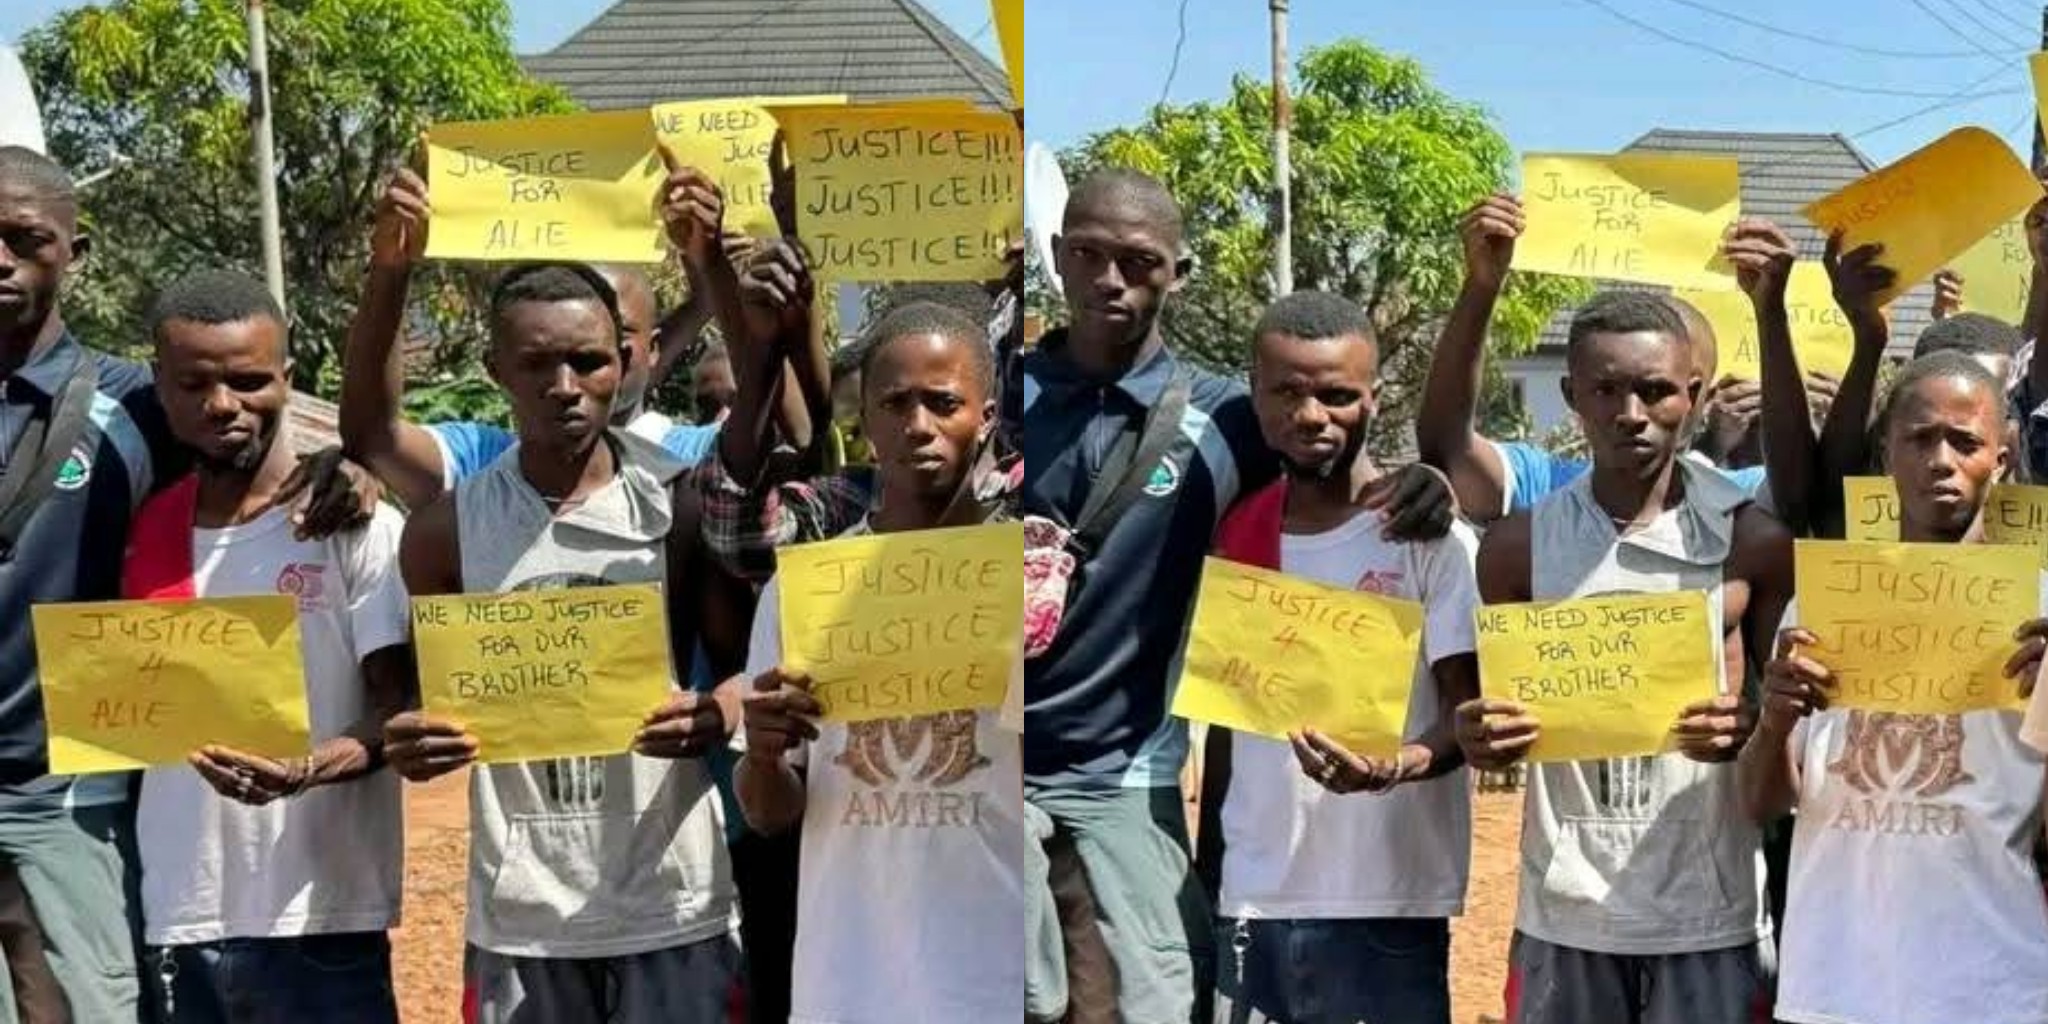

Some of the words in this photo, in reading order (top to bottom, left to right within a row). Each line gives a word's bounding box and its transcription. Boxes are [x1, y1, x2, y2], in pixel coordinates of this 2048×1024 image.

[654, 112, 683, 134] WE
[697, 109, 759, 133] NEED
[446, 145, 585, 178] JUSTICE
[809, 127, 1013, 164] JUSTICE!!!
[510, 178, 563, 203] FOR
[806, 173, 1013, 216] JUSTICE!!!
[1536, 172, 1669, 209] JUSTICE
[485, 219, 572, 256] ALIE
[1594, 208, 1642, 234] FOR
[1568, 242, 1643, 274] ALIE
[808, 548, 1002, 597] JUSTICE
[1824, 558, 2018, 605] JUSTICE
[414, 602, 448, 626] WE
[465, 600, 534, 624] NEED
[542, 597, 644, 624] JUSTICE
[1226, 574, 1386, 638] JUSTICE
[1477, 612, 1509, 634] WE
[1524, 608, 1588, 631] NEED
[1597, 605, 1688, 628] JUSTICE
[71, 612, 252, 645] JUSTICE
[478, 634, 522, 658] FOR
[805, 603, 1001, 664] JUSTICE
[1271, 624, 1298, 653] 4
[1825, 618, 2003, 655] JUSTICE
[137, 650, 165, 682] 4
[1535, 640, 1576, 663] FOR
[451, 659, 589, 699] BROTHER
[813, 662, 988, 710] JUSTICE
[1510, 663, 1640, 702] BROTHER
[1828, 666, 1987, 703] JUSTICE
[90, 698, 180, 729] ALIE
[840, 790, 986, 830] AMIRI
[1832, 801, 1968, 836] AMIRI
